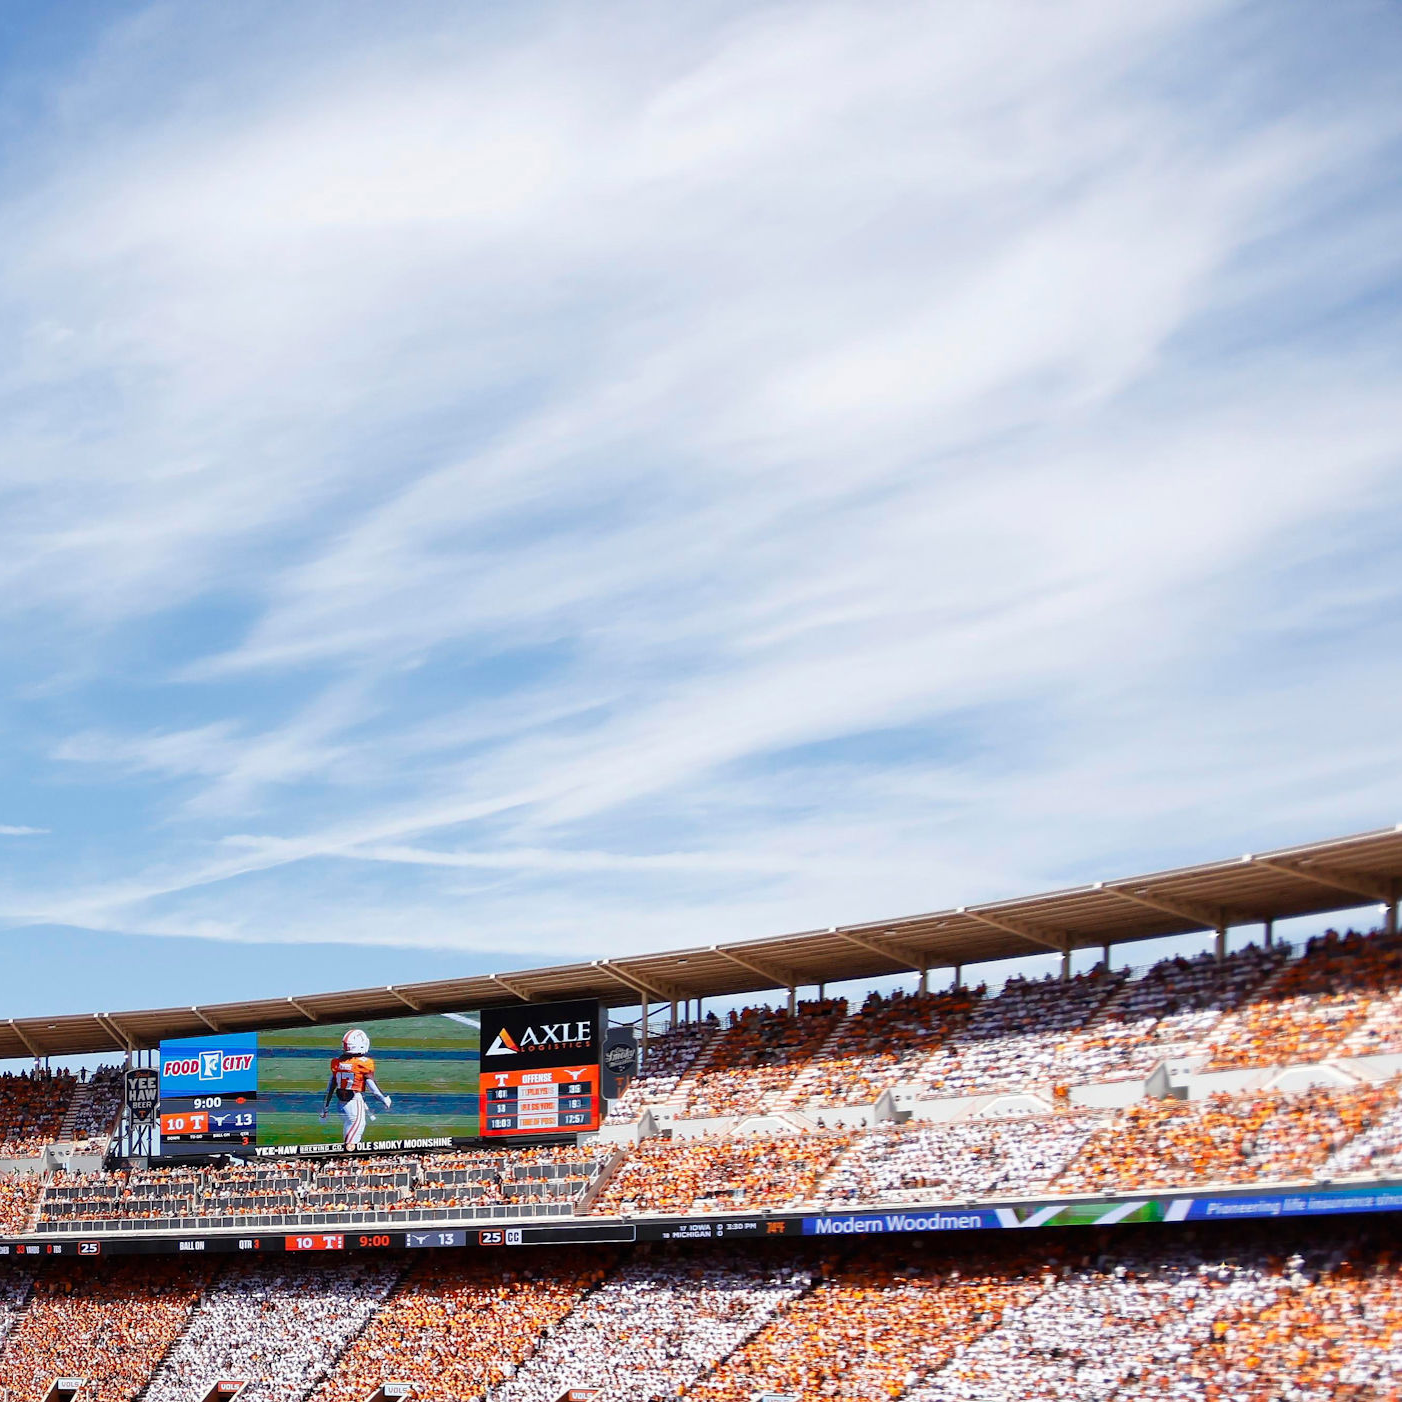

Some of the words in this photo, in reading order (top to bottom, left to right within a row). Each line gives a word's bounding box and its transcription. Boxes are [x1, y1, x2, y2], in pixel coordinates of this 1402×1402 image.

[520, 1021, 591, 1047] AXLE
[521, 1041, 591, 1052] LOGISTICS
[164, 1059, 199, 1076] FOOD
[222, 1055, 253, 1071] CITY
[128, 1077, 156, 1089] YEE
[522, 1073, 552, 1084] OFFENSE
[129, 1089, 157, 1101] HAW
[193, 1097, 222, 1109] 9:00
[167, 1118, 184, 1130] 10
[235, 1114, 252, 1126] 13
[242, 1137, 249, 1145] 3
[255, 1145, 298, 1157] YEE-HAW
[357, 1141, 372, 1151] OLE
[373, 1139, 402, 1150] SMOKY
[403, 1137, 453, 1149] MOONSHINE
[816, 1218, 883, 1234] Modern
[886, 1213, 981, 1232] Woodmen
[359, 1235, 390, 1247] 9:00
[438, 1233, 454, 1244] 13
[482, 1232, 501, 1243] 25
[507, 1232, 520, 1243] CC
[81, 1243, 98, 1253] 25
[179, 1241, 194, 1251] BALL
[195, 1241, 205, 1250] ON
[239, 1240, 252, 1249] QTR
[253, 1239, 259, 1249] 3
[296, 1238, 313, 1249] 10
